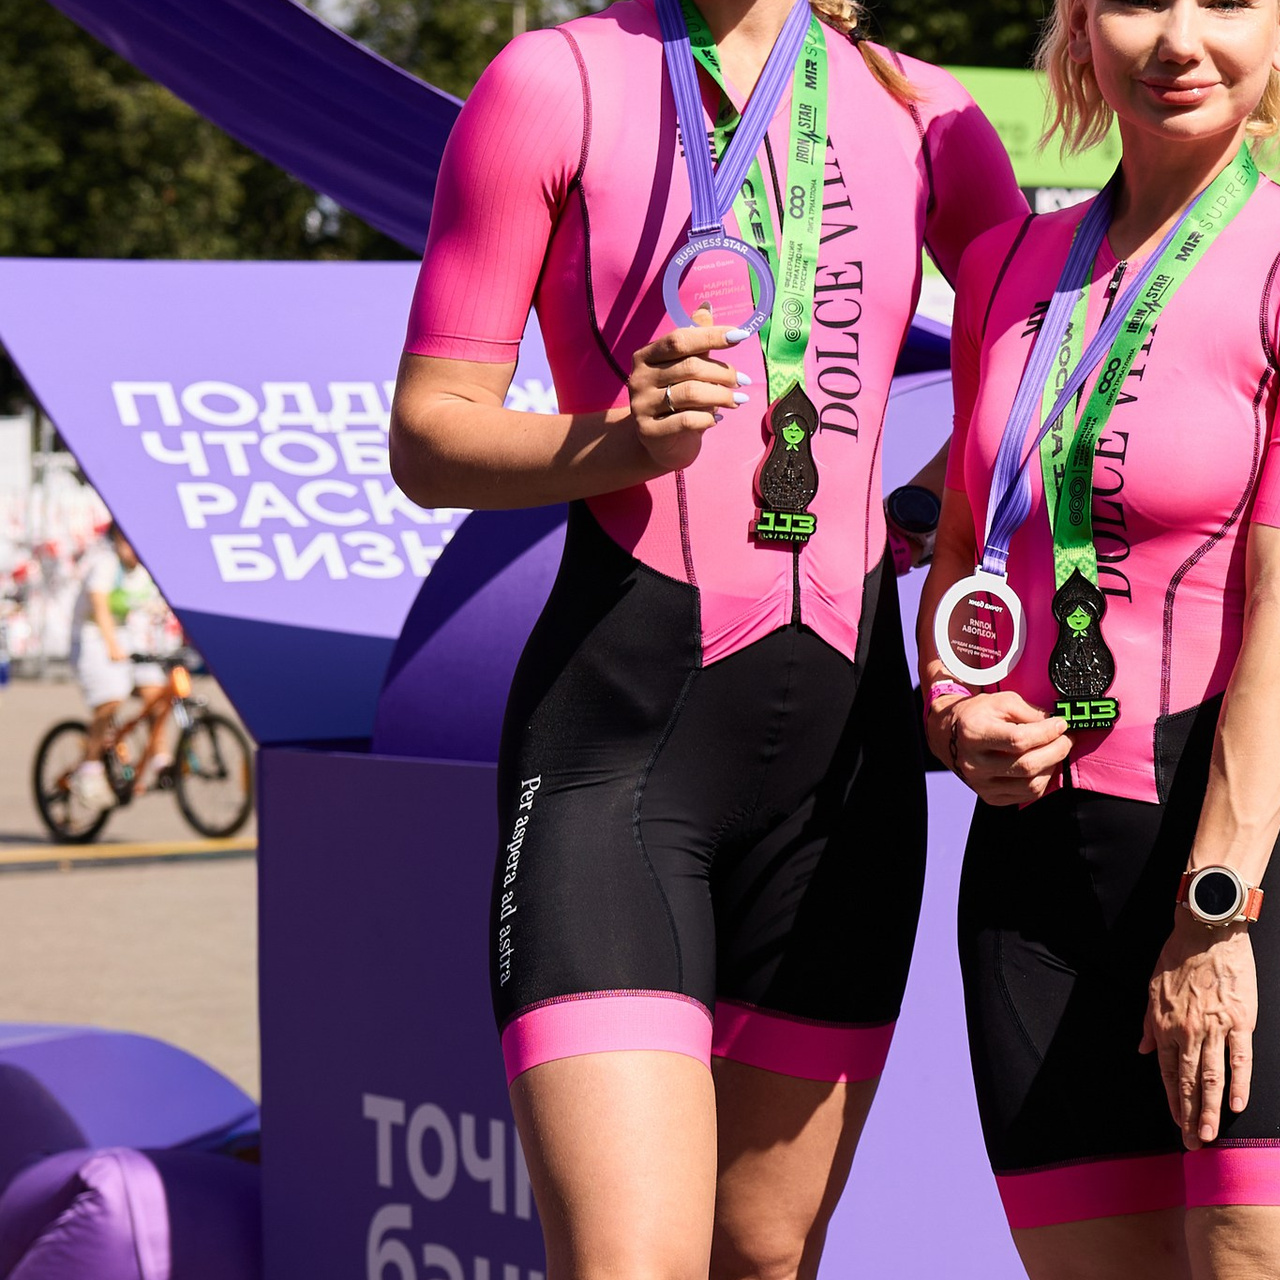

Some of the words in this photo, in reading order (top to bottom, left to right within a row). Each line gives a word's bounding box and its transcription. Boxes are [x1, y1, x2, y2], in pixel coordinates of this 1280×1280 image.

[805, 59, 818, 90] MIR
[798, 103, 812, 129] STAR
[796, 140, 810, 164] IRON
[675, 237, 722, 266] BUSINESS
[723, 238, 749, 255] STAR
[792, 243, 803, 289] ТРИАТЛОНА
[1175, 230, 1205, 262] MIR
[1126, 308, 1148, 334] IRON
[1146, 274, 1170, 299] STAR
[813, 261, 863, 444] DOLCE
[1050, 321, 1074, 458] МОСВА
[140, 430, 391, 477] ЧТОБ
[176, 480, 475, 530] РАСК
[757, 512, 815, 534] 113
[210, 529, 458, 583] БИЗН
[1057, 700, 1116, 721] 113
[518, 774, 542, 811] Per
[503, 815, 530, 888] aspera
[500, 890, 518, 921] ad
[498, 924, 515, 988] astra
[362, 1092, 533, 1220] точ
